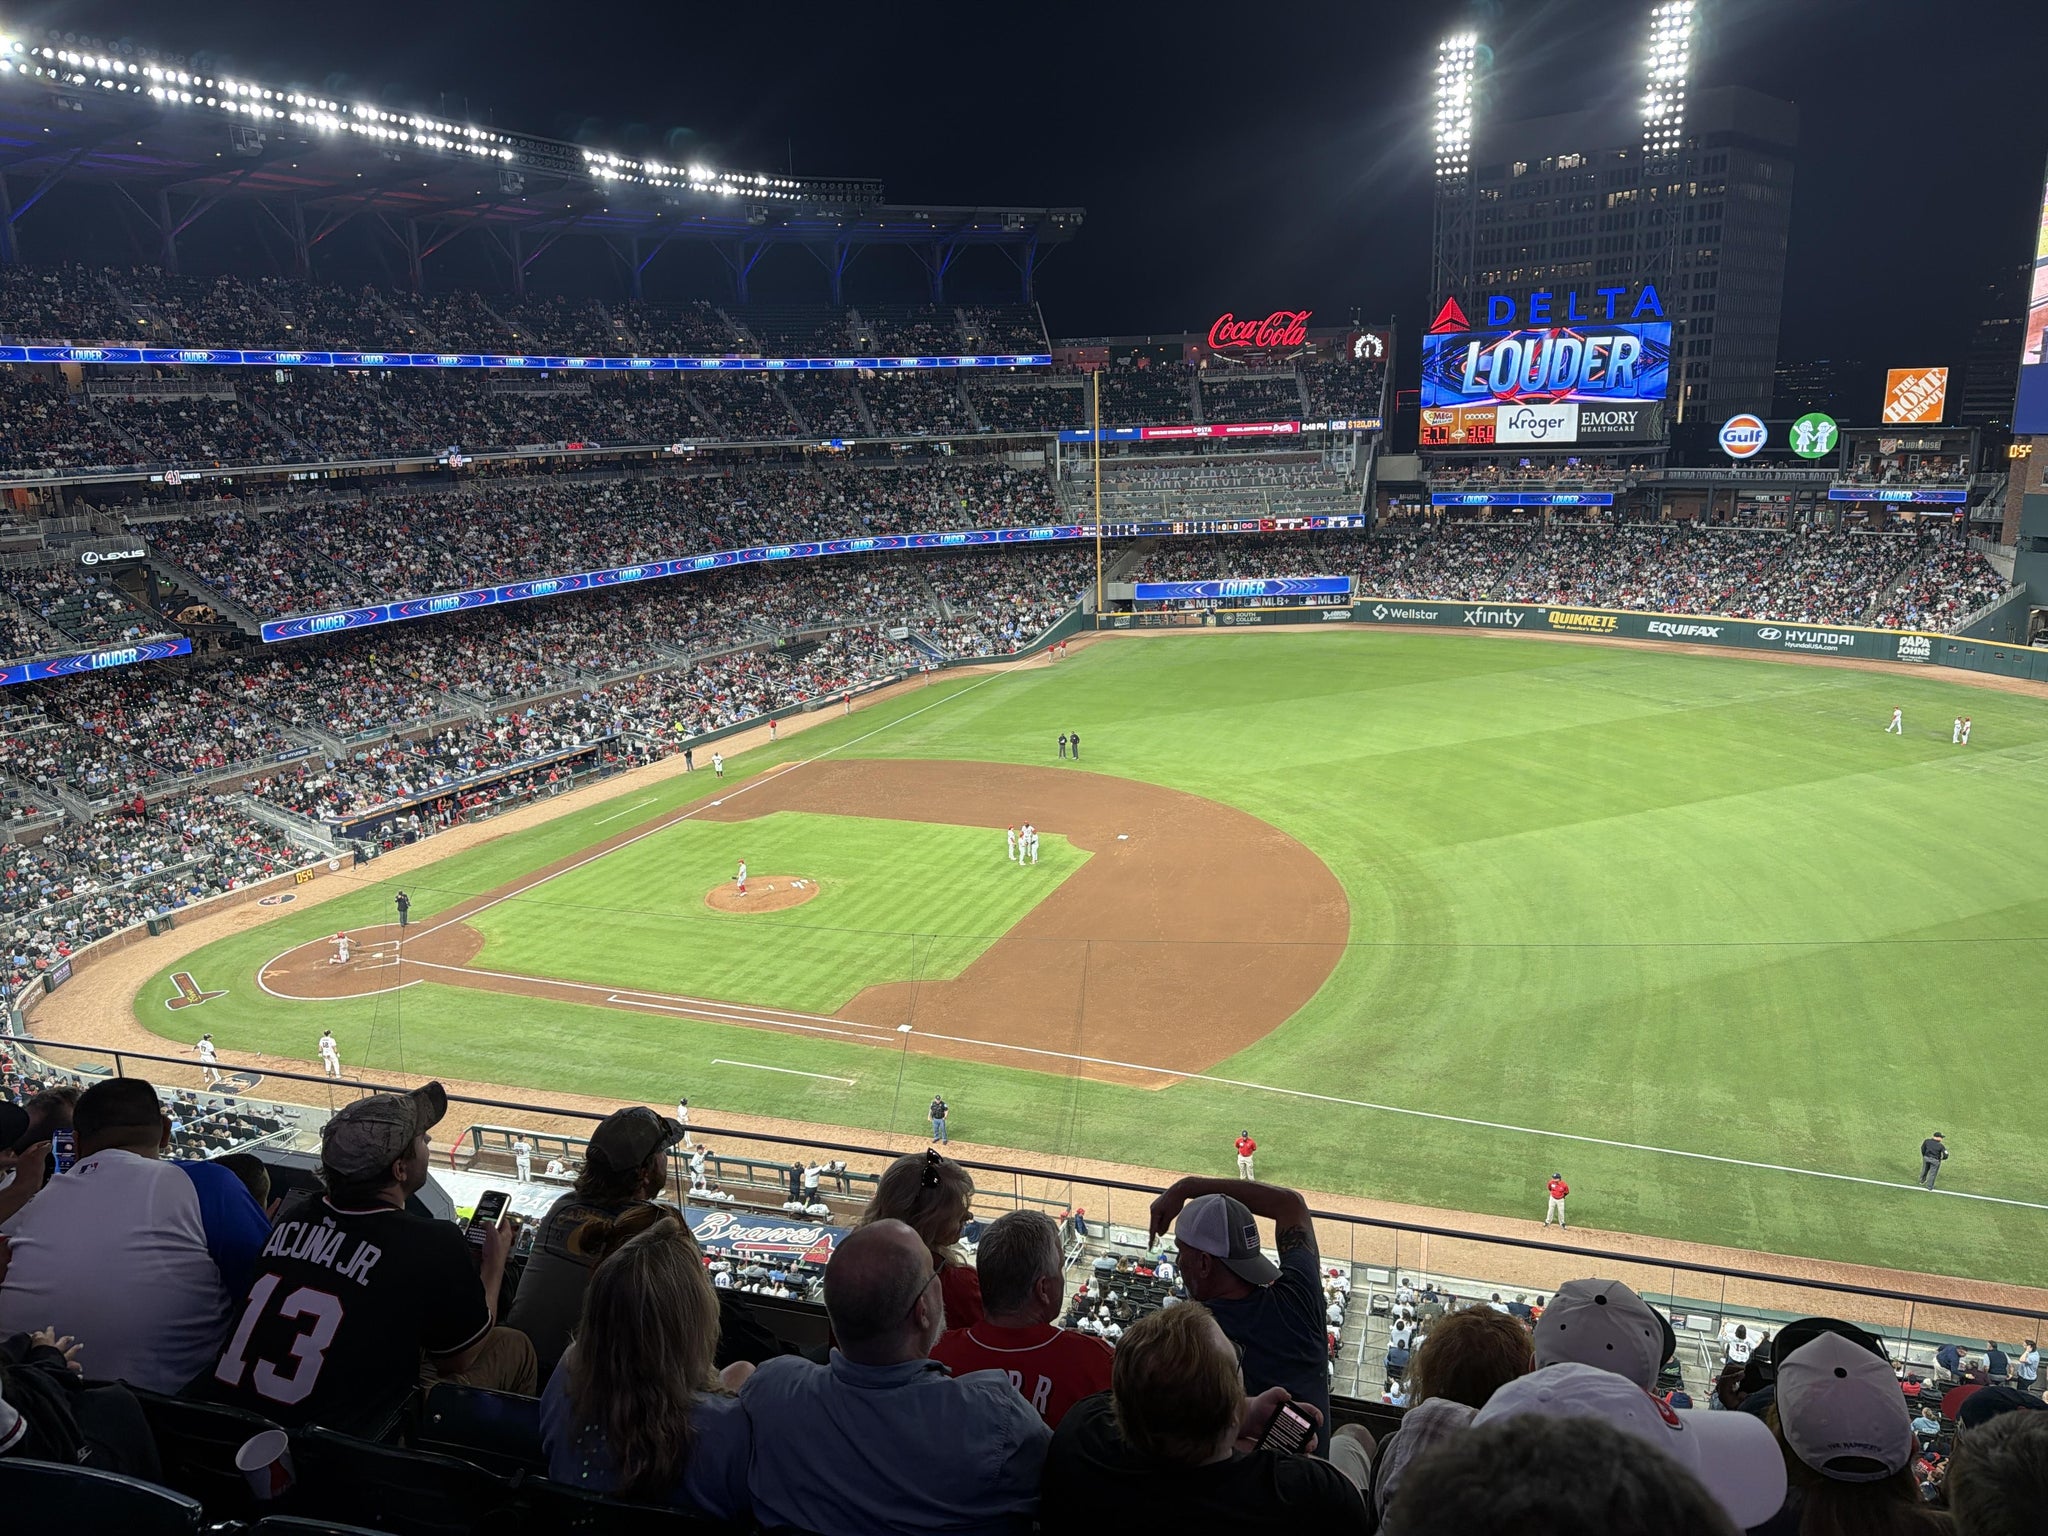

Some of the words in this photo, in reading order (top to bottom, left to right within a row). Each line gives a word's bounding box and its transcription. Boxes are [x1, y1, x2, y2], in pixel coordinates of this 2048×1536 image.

[1487, 285, 1664, 326] DELTA
[1208, 310, 1313, 348] Coca-Cola
[70, 350, 102, 360] LOUDER
[180, 351, 208, 362] LOUDER
[276, 353, 301, 363] LOUDER
[361, 354, 384, 364] LOUDER
[1462, 335, 1642, 394] LOUDER
[1892, 374, 1917, 396] THE
[1884, 368, 1946, 422] HOME
[1906, 388, 1944, 422] DEPOT
[1509, 408, 1564, 439] Kroger
[1581, 411, 1638, 426] EMORY
[1423, 427, 1448, 438] 277
[1468, 426, 1494, 438] 360
[1581, 425, 1634, 433] HEALTHCARE
[1723, 430, 1762, 445] Gulf
[1897, 440, 1940, 450] CLUBHOUSE
[449, 455, 463, 467] 44
[165, 470, 181, 485] 41
[1142, 472, 1182, 490] HANK
[1190, 470, 1240, 488] AARON
[1462, 495, 1488, 504] LOUDER
[1552, 495, 1579, 504] LOUDER
[1880, 491, 1912, 501] LOUDER
[940, 534, 965, 544] LOUDER
[1029, 529, 1053, 539] LOUDER
[850, 539, 874, 550] LOUDER
[99, 550, 145, 561] LEXUS
[765, 547, 790, 559] LOUDER
[694, 557, 715, 569] LOUDER
[619, 568, 642, 580] LOUDER
[531, 582, 557, 594] LOUDER
[1219, 582, 1266, 598] LOUDER
[429, 597, 460, 612] LOUDER
[1196, 599, 1224, 608] MLB+
[1262, 597, 1290, 606] MLB+
[1318, 595, 1346, 604] MLB+
[1390, 608, 1438, 620] Wellstar
[1464, 606, 1524, 627] xfinity
[1549, 611, 1618, 629] QUIKRETE
[310, 614, 346, 632] LOUDER
[1647, 621, 1720, 638] EQUIFAX
[1785, 630, 1854, 646] HYUNDAI
[1899, 636, 1931, 648] PAPA
[1784, 641, 1838, 652] HyundaiUSA.com
[1897, 646, 1930, 656] JOHNS
[92, 649, 138, 669] LOUDER
[692, 1212, 823, 1244] Braves
[262, 1216, 346, 1268] ACUÑA
[717, 1277, 726, 1286] 44
[214, 1272, 344, 1405] 13
[1735, 1344, 1747, 1353] 13
